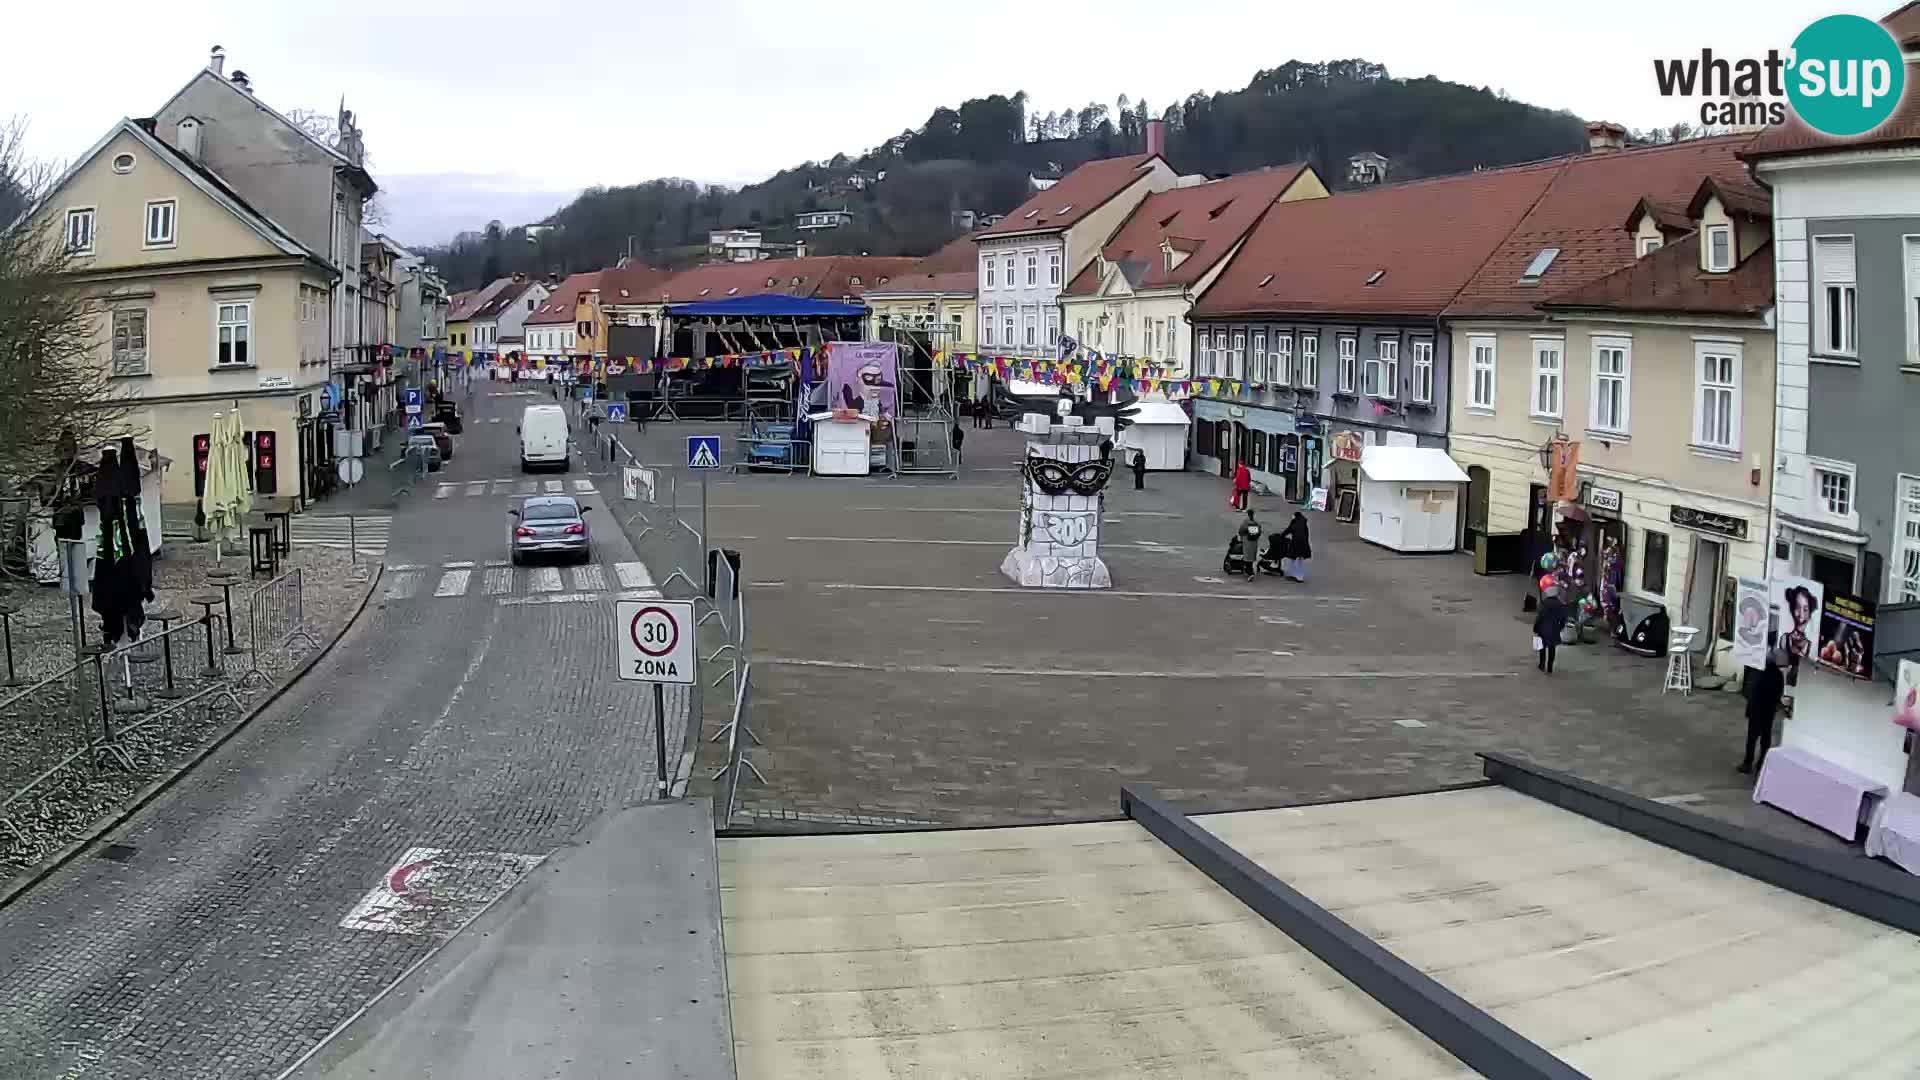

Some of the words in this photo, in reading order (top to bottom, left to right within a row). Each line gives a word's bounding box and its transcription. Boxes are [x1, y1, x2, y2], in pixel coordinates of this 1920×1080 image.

[409, 391, 417, 402] P
[1048, 516, 1087, 545] 200
[643, 622, 667, 643] 30
[633, 659, 678, 677] ZONA
